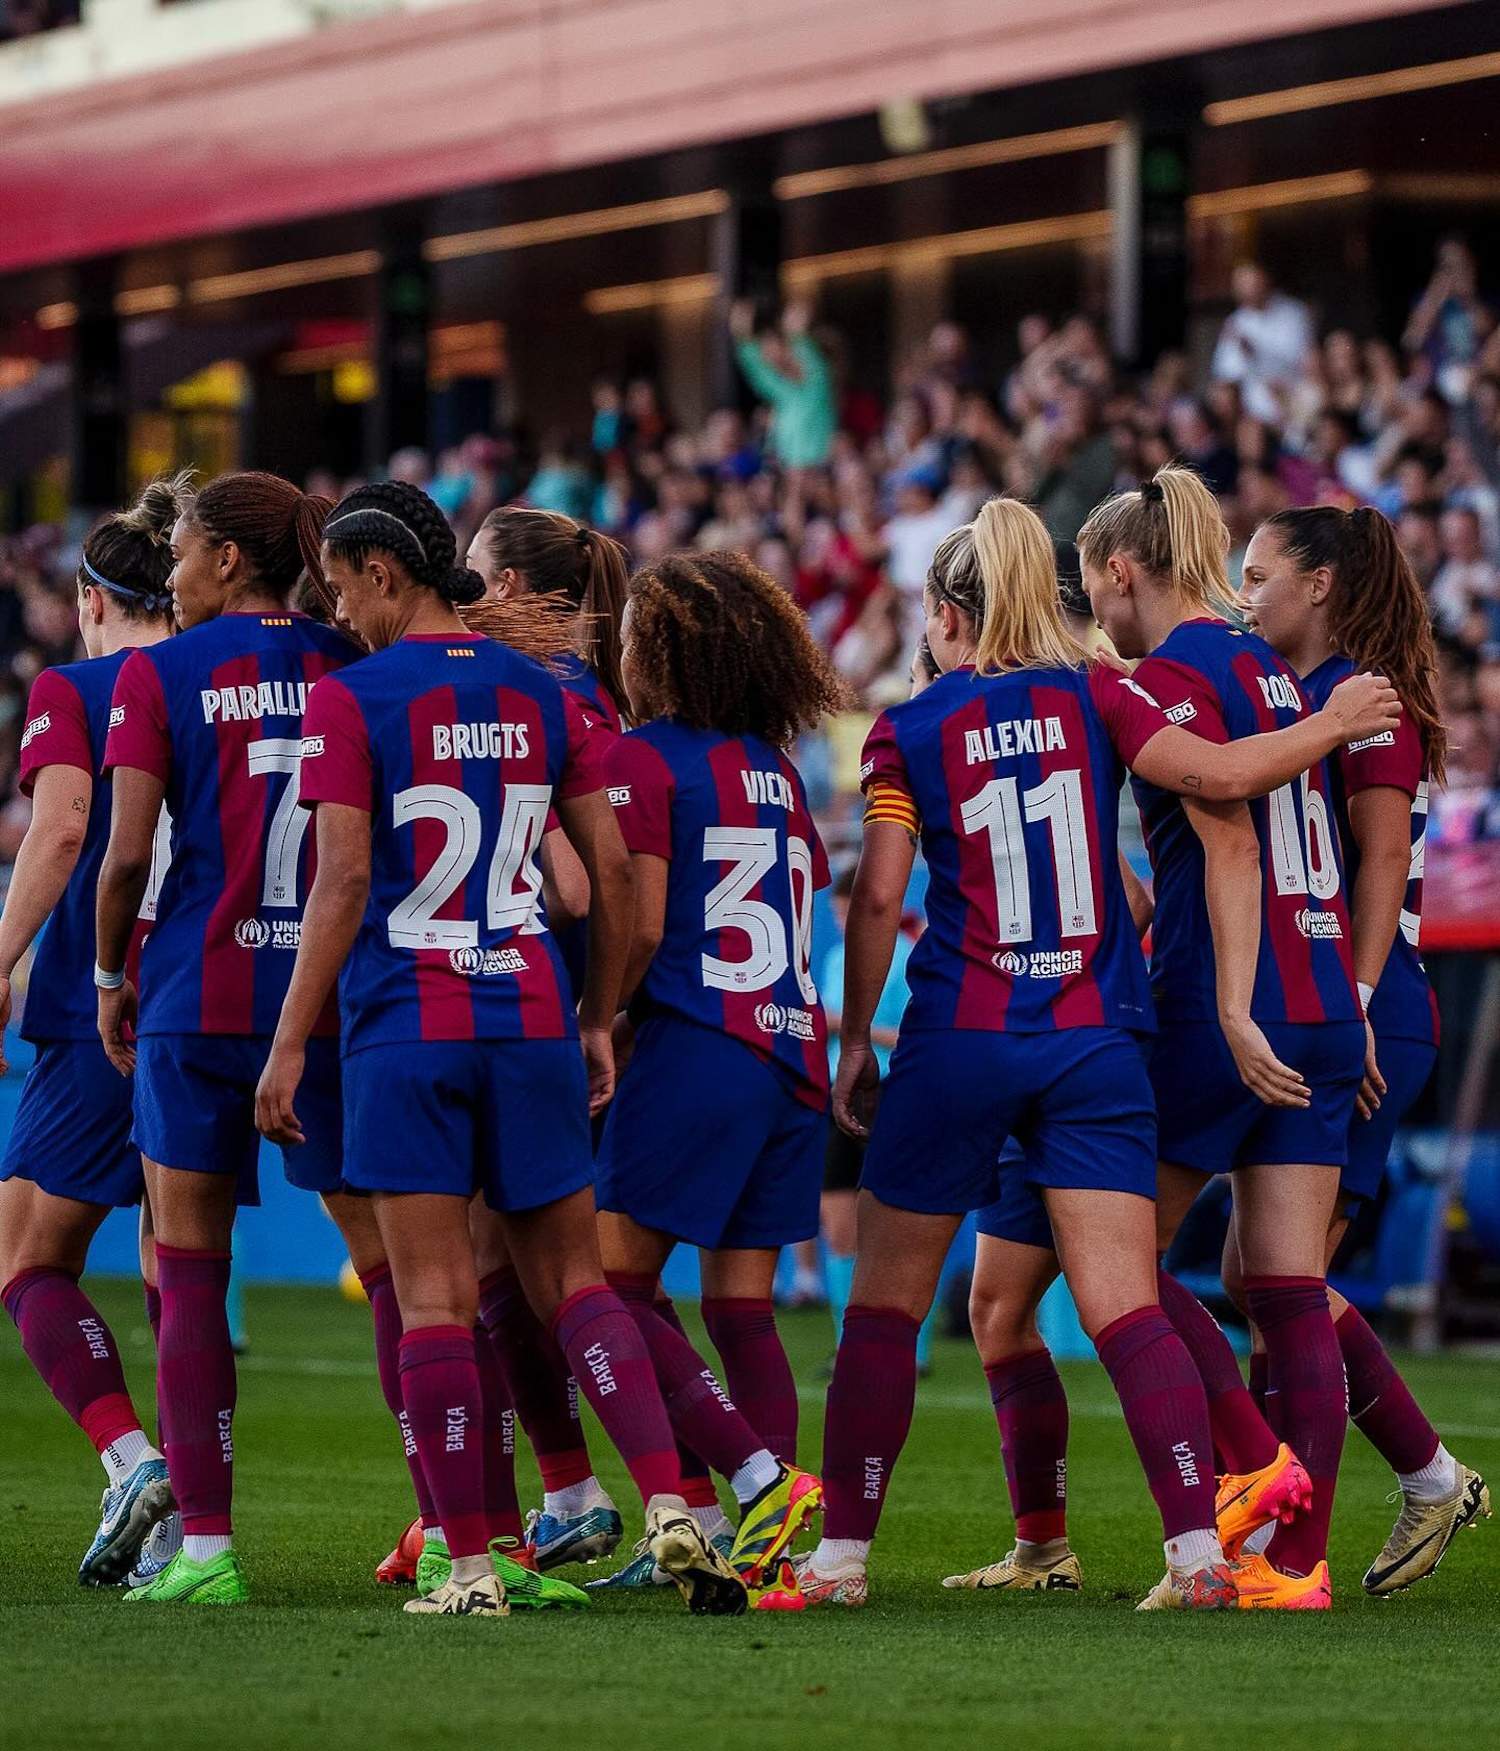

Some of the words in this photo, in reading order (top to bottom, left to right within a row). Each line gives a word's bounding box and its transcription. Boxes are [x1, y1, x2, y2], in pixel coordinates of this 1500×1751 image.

[433, 723, 529, 760] BRUGTS
[964, 716, 1067, 765] ALEXIA
[247, 738, 312, 907] 7
[1269, 768, 1340, 899] 16
[388, 784, 553, 949] 24
[960, 769, 1098, 943] 11
[272, 921, 303, 932] UNH
[272, 932, 301, 944] ACN
[702, 826, 817, 1005] 30
[482, 958, 527, 972] ACNUR
[1030, 950, 1082, 964] UNHCR
[1030, 960, 1082, 975] ACNUR
[584, 1342, 617, 1396] BARÇA
[446, 1406, 469, 1452] BARÇA
[864, 1456, 883, 1499] BARÇA
[1172, 1440, 1200, 1487] BARÇA
